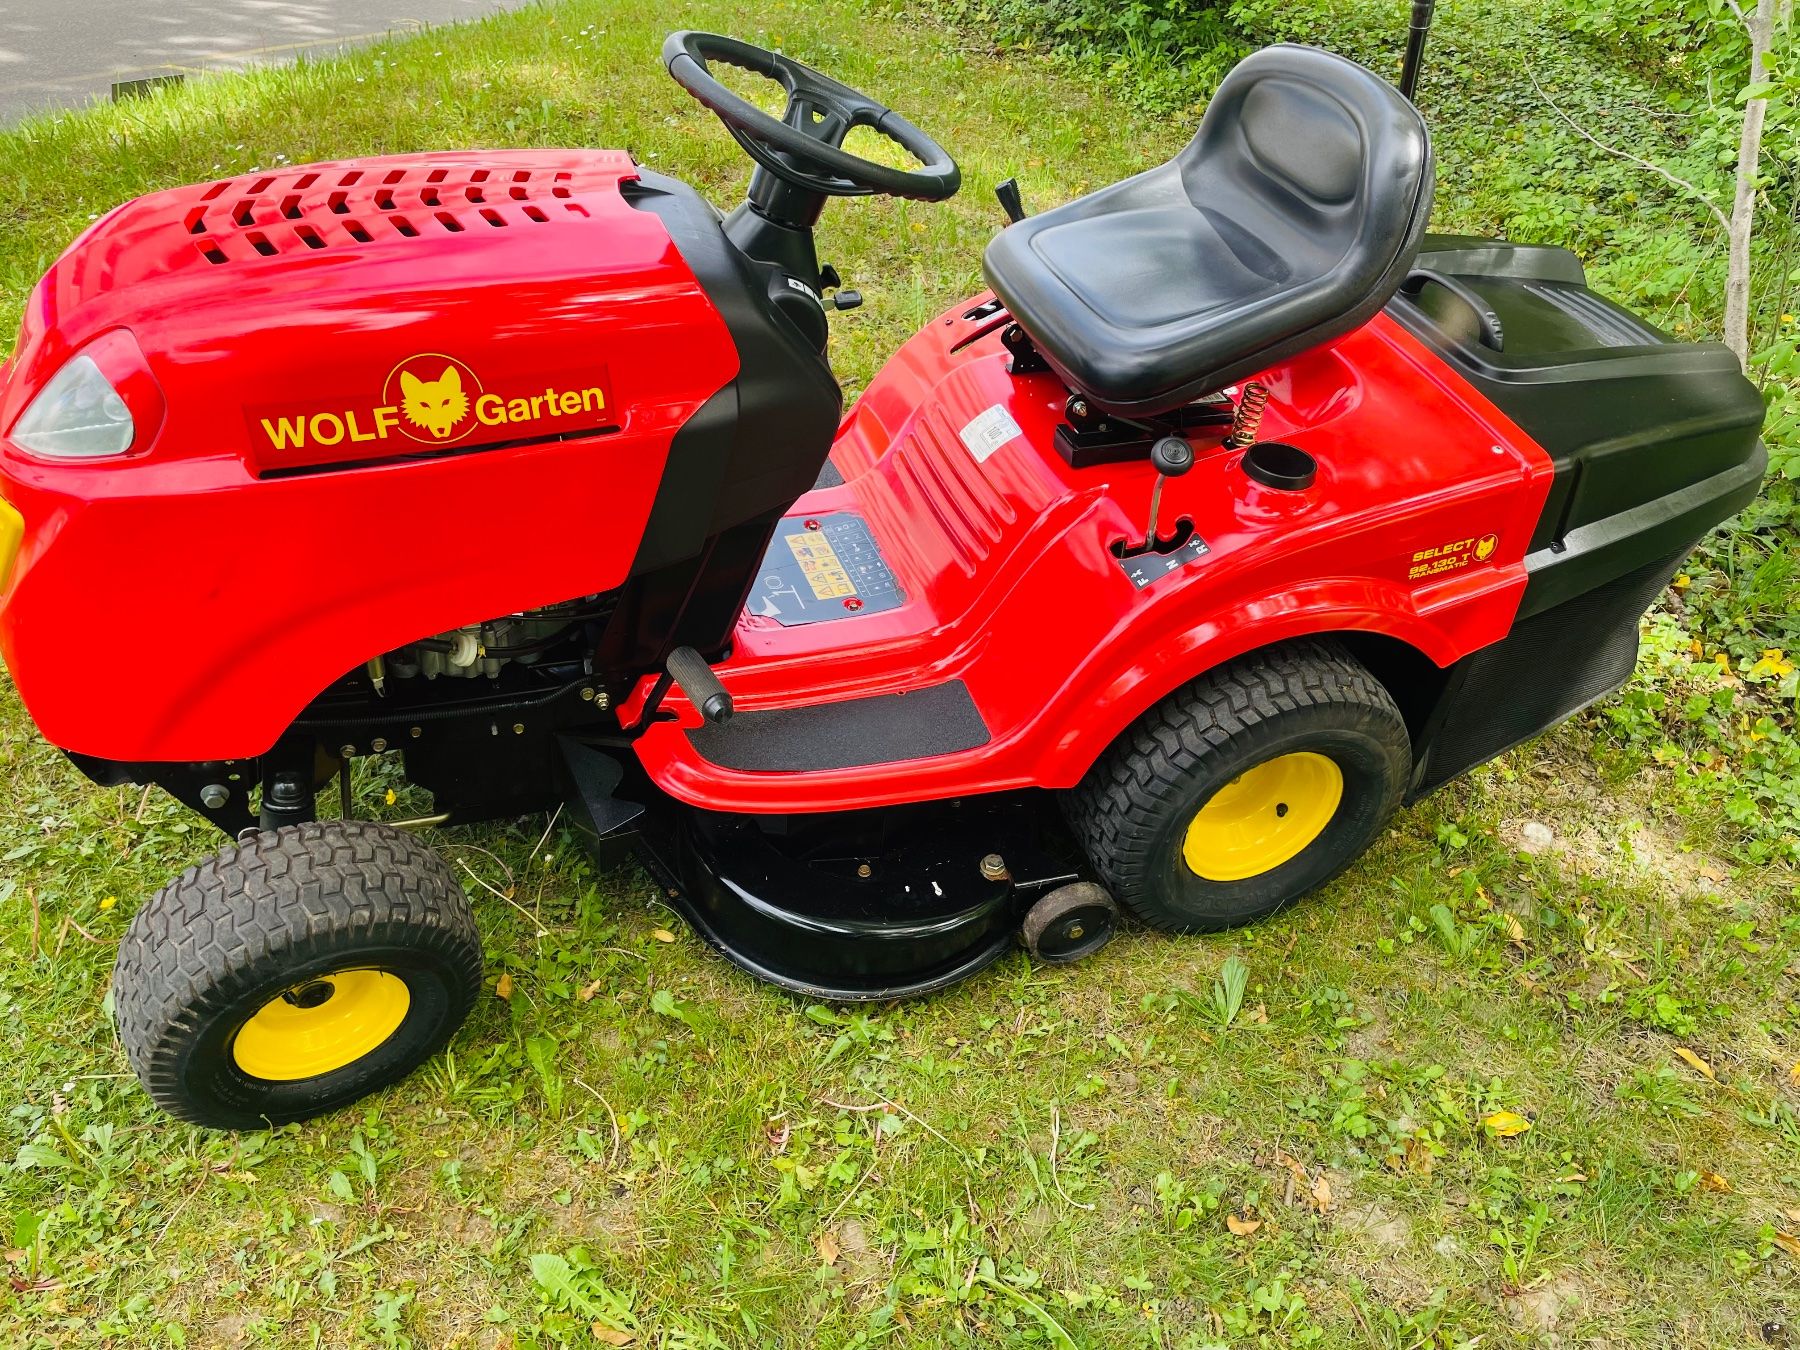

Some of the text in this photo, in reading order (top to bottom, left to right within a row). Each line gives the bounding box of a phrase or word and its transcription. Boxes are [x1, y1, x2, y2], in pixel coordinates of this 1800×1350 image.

[260, 387, 605, 449] WOLF Garten
[1195, 544, 1208, 554] R
[1412, 538, 1474, 562] SELECT
[1462, 553, 1471, 561] T
[1166, 559, 1179, 570] N
[1408, 560, 1468, 580] TRANSMATIC
[1137, 577, 1149, 587] F
